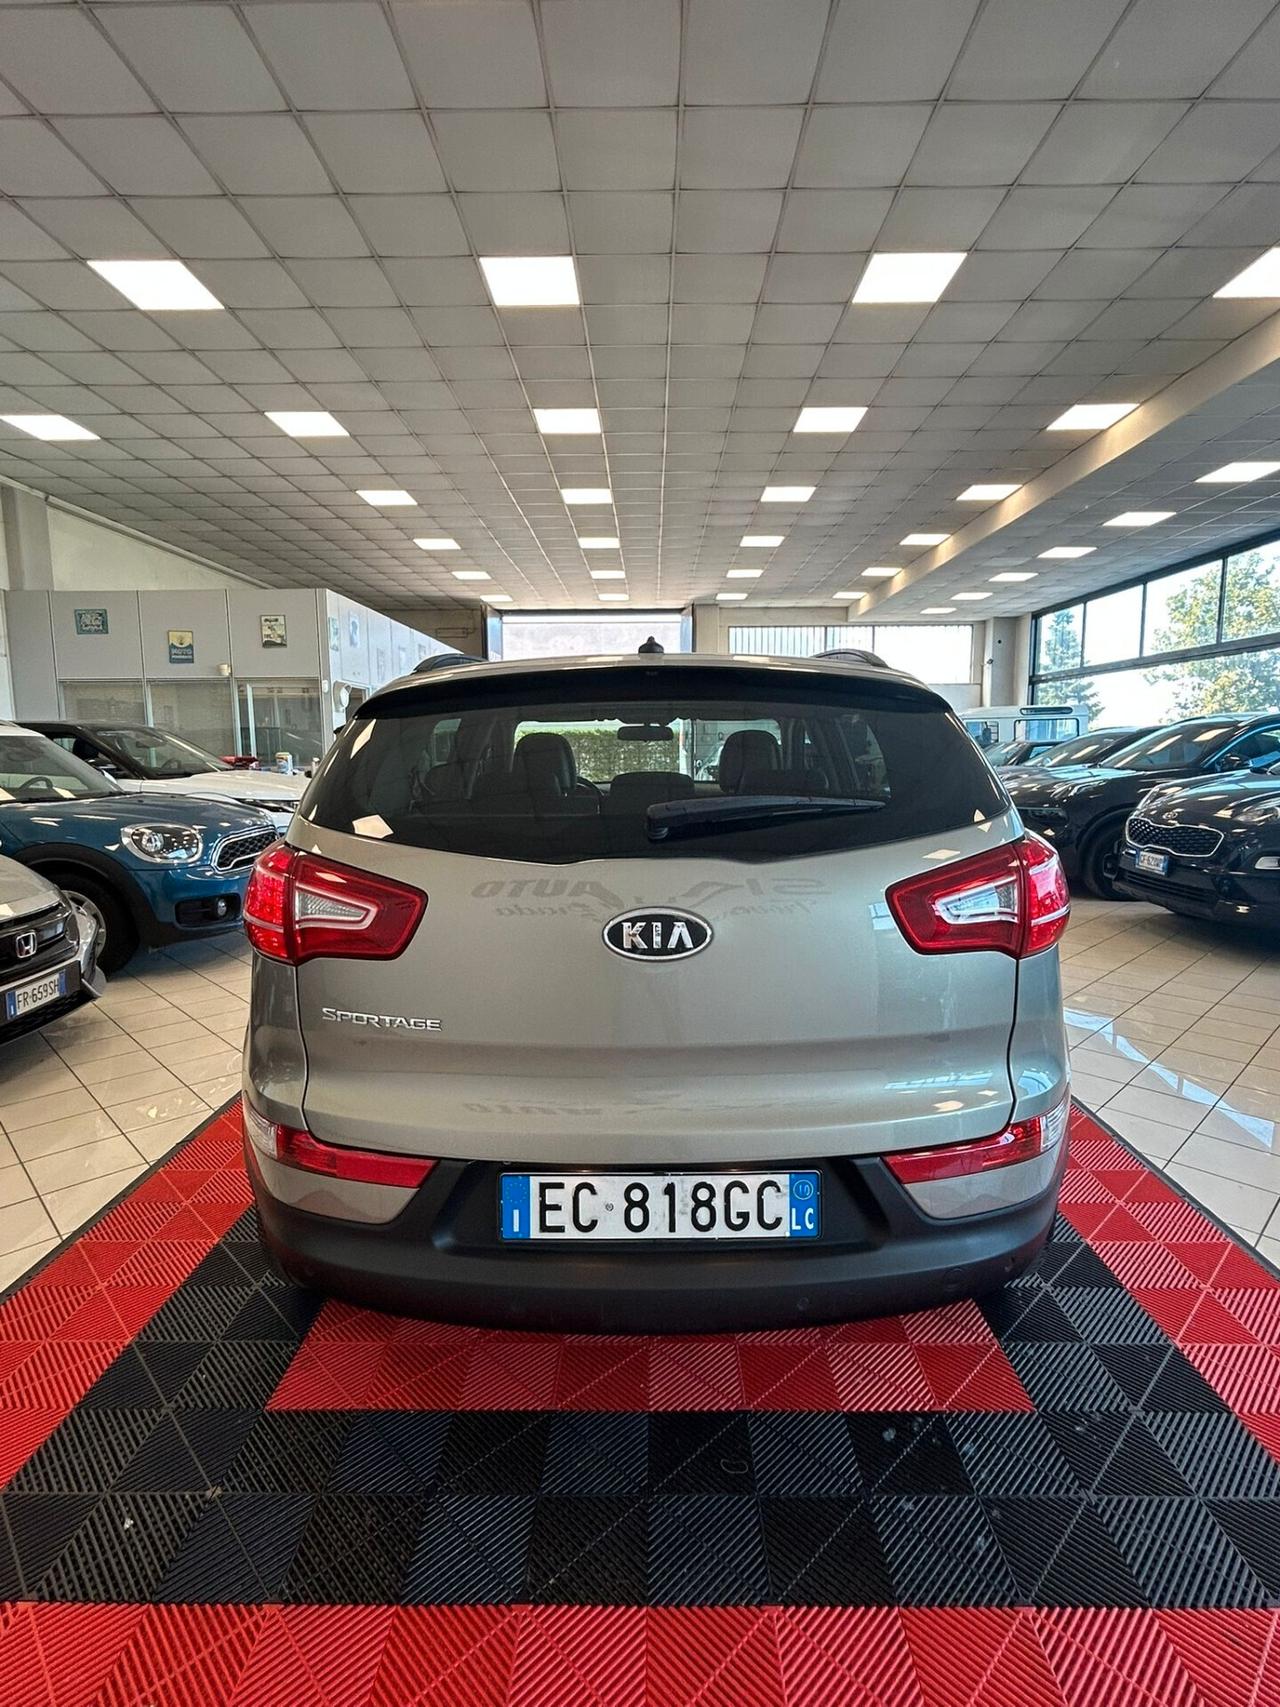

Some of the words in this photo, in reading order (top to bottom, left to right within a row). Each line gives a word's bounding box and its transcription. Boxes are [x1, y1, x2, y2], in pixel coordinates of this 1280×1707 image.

[621, 922, 694, 949] KIA
[322, 1007, 442, 1032] SPORTAGE
[539, 1182, 598, 1232] EC
[623, 1180, 783, 1232] 818GC
[791, 1207, 814, 1230] LC
